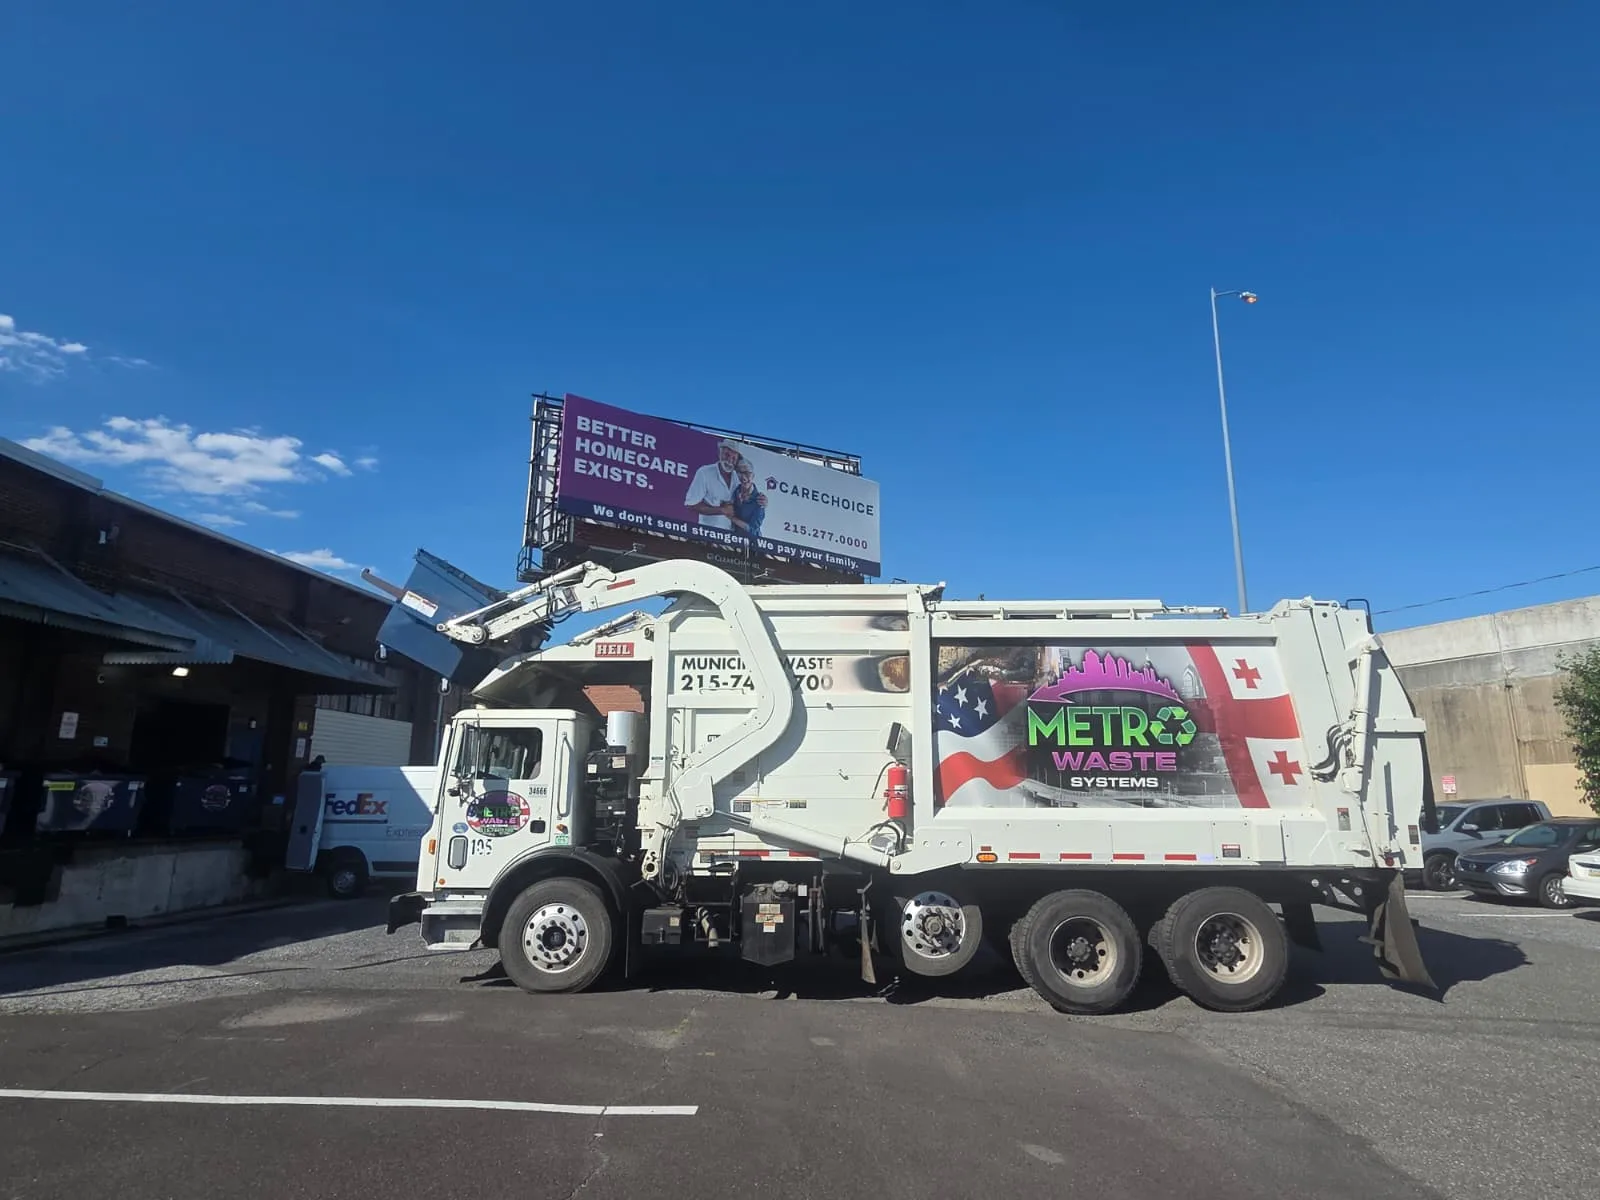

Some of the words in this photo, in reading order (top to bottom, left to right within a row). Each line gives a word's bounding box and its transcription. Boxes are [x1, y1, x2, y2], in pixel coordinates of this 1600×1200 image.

[577, 415, 657, 450] BETTER
[575, 436, 689, 478] HOMECARE
[574, 457, 654, 490] EXISTS.
[779, 481, 874, 516] CARECHOICE
[593, 504, 614, 518] We
[618, 510, 653, 526] don't
[657, 520, 688, 533] send
[757, 538, 774, 550] We
[777, 545, 796, 557] pay
[800, 549, 822, 562] your
[825, 554, 859, 569] family.
[784, 521, 868, 550] 215.277.0000
[597, 644, 631, 655] HEIL
[681, 674, 755, 691] 215-74
[793, 674, 834, 691] 700
[1051, 751, 1177, 772] WASTE
[1070, 777, 1159, 788] SYSTEMS
[324, 792, 389, 816] FedEx
